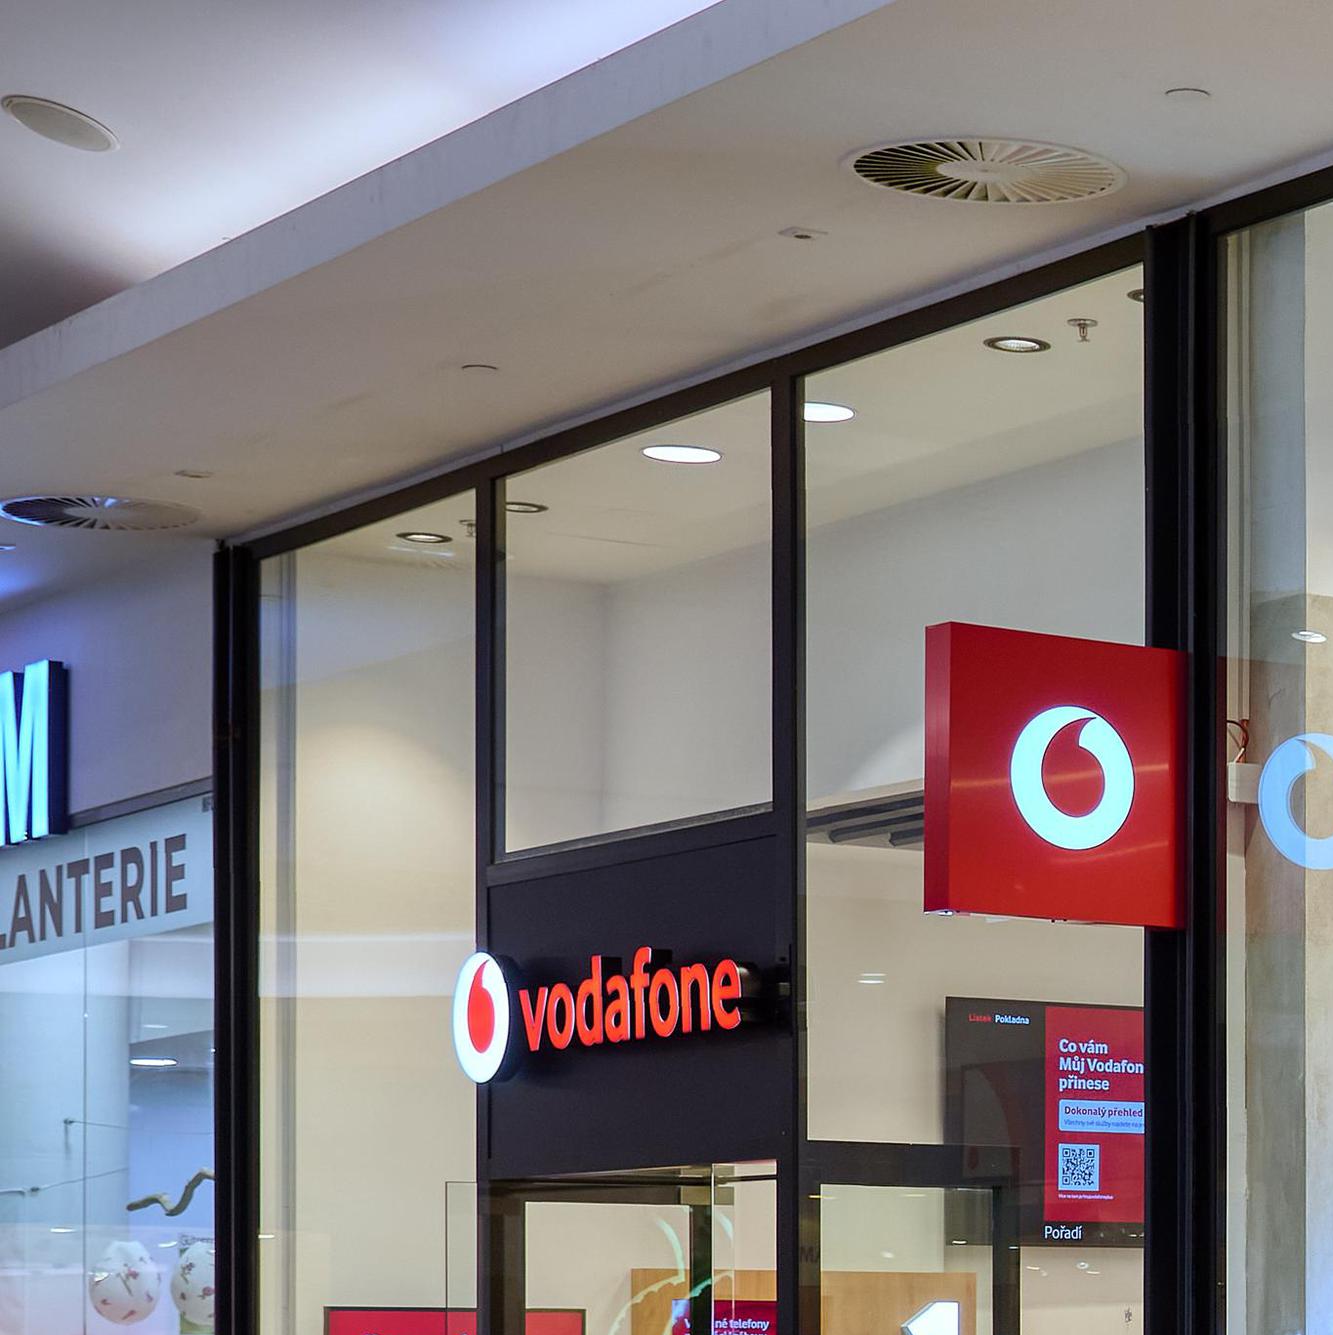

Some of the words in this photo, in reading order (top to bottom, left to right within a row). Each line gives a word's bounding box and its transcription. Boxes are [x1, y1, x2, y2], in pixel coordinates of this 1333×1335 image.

[519, 946, 742, 1052] vodafone
[994, 1014, 1030, 1025] Pokladna
[1059, 1039, 1077, 1053] Co
[1080, 1040, 1109, 1054] vám
[1059, 1056, 1085, 1074] Můj
[1088, 1060, 1144, 1074] Vodafon
[1059, 1074, 1110, 1092] přinese
[1064, 1105, 1106, 1119] Dokonalý
[1107, 1107, 1143, 1119] přehled
[1044, 1225, 1083, 1240] Pořadí
[729, 1319, 769, 1331] telefony
